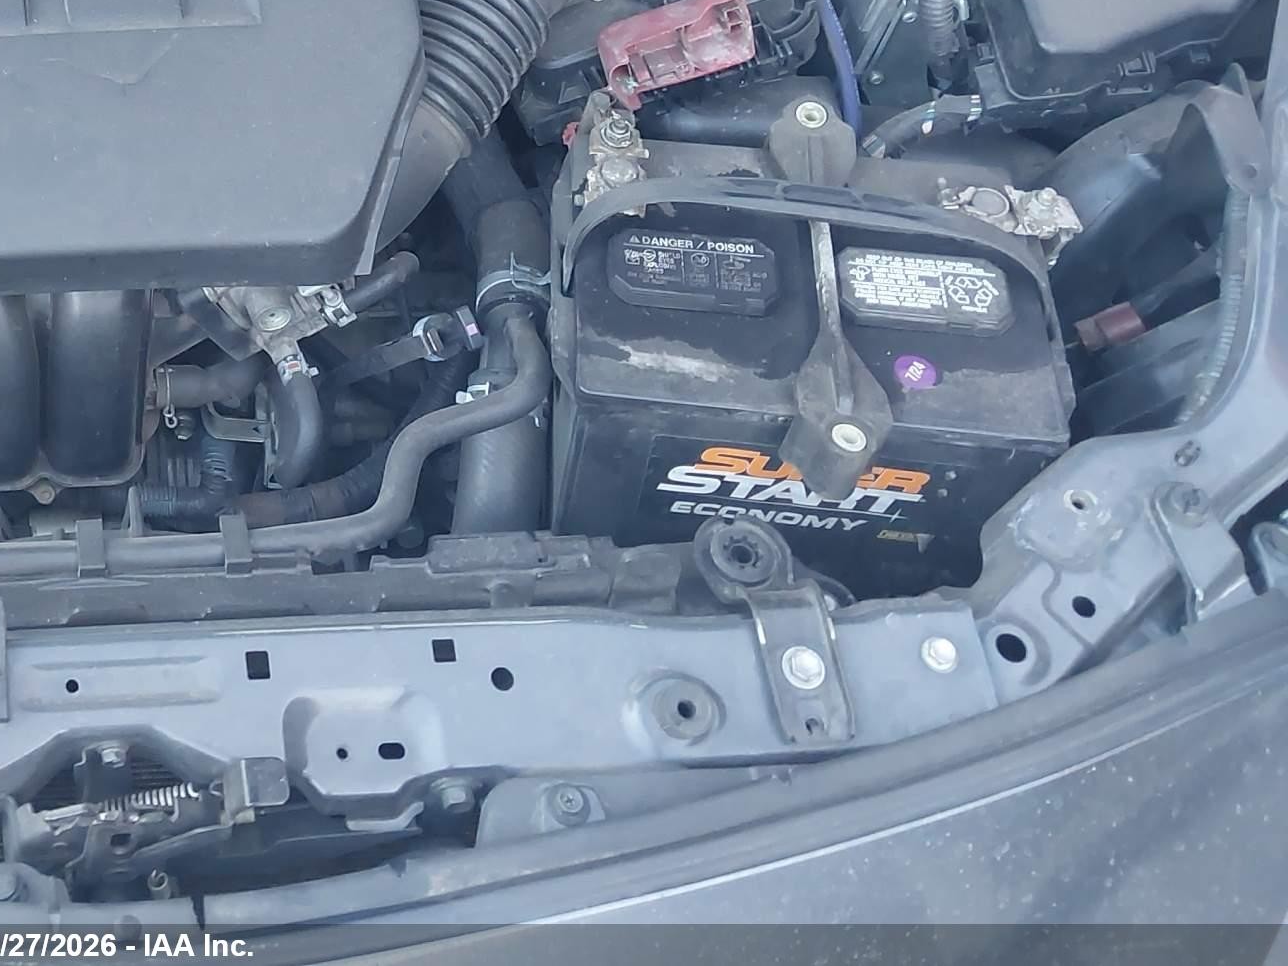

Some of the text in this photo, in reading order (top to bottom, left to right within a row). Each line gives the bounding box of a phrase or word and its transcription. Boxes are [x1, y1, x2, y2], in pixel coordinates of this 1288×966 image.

[642, 235, 754, 254] DANGER / POISON
[904, 361, 926, 381] 7/24
[694, 446, 931, 494] SUER
[669, 501, 869, 531] ECONOMY
